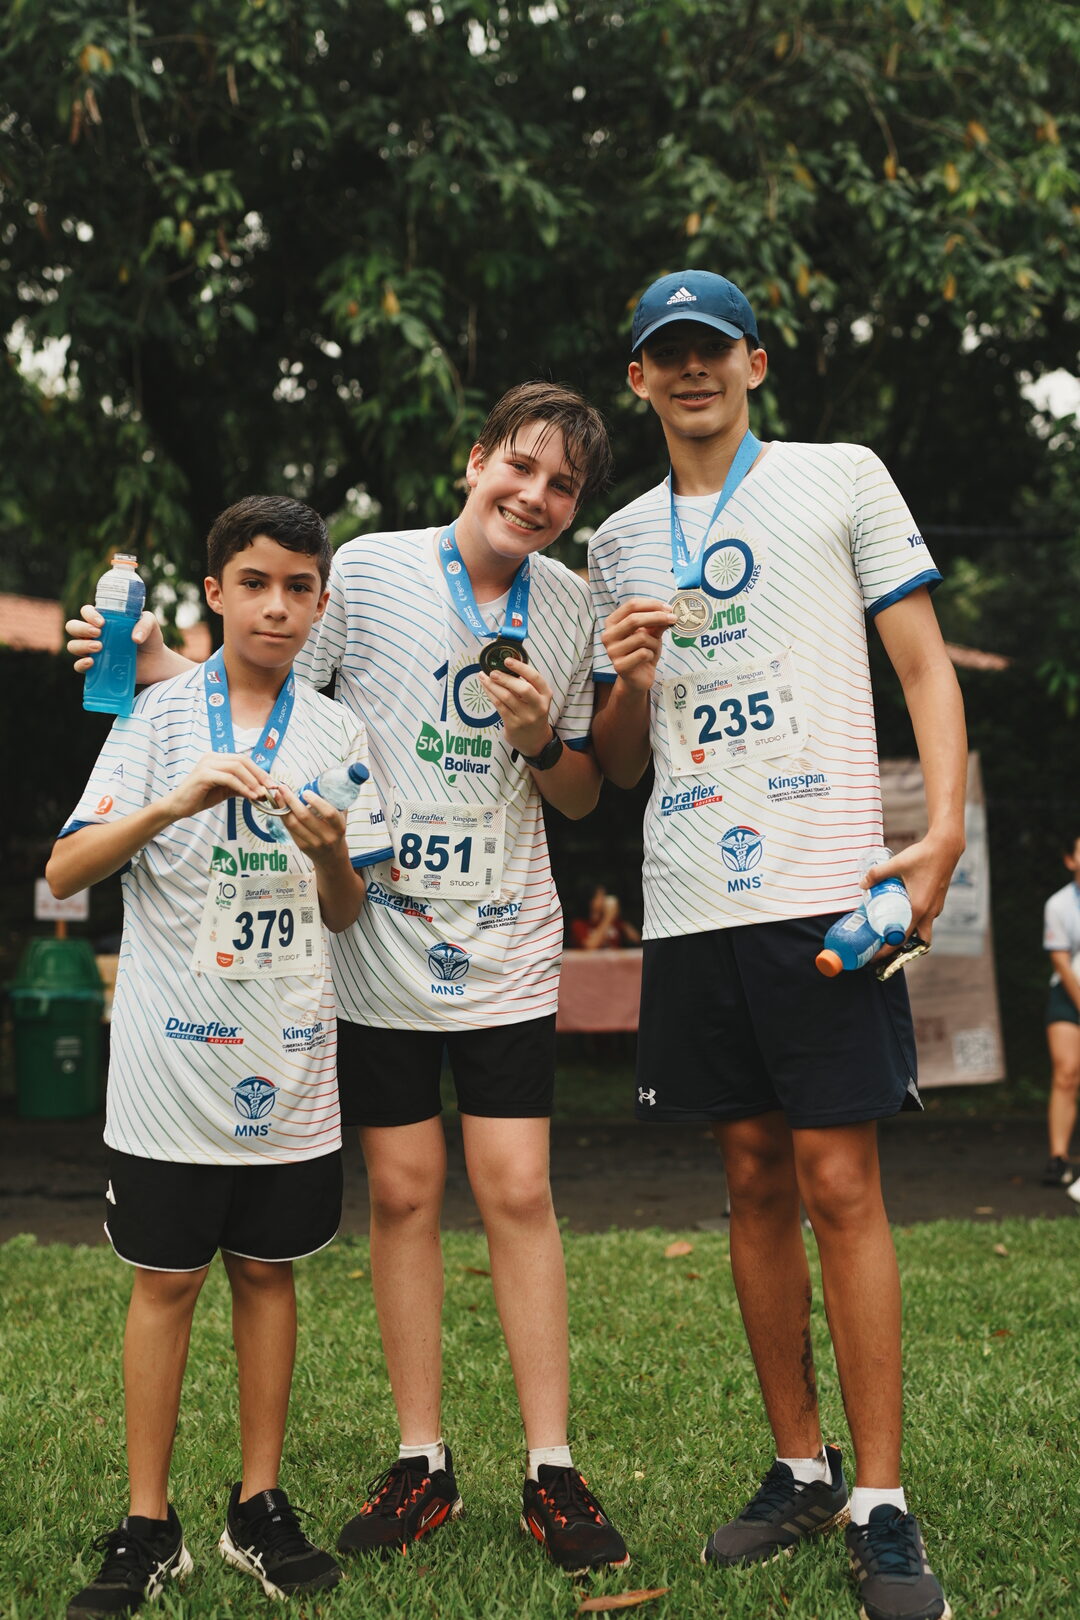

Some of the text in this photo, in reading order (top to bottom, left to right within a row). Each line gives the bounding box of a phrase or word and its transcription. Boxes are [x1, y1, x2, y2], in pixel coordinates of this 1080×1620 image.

[743, 564, 762, 594] YEARS
[709, 603, 746, 630] erde
[700, 628, 748, 648] Bolívar
[736, 670, 764, 681] Kingspan
[696, 679, 728, 692] Duraflex
[693, 691, 775, 744] 235
[417, 729, 492, 758] 5K Verde
[755, 735, 781, 746] STUDIO
[444, 757, 490, 774] Bolívar
[768, 773, 825, 790] Kingspan
[661, 784, 716, 809] Draflex
[411, 813, 444, 822] Duraflex
[452, 815, 478, 823] Kingspan
[211, 847, 287, 872] 5K Verde
[399, 832, 472, 873] 851
[219, 882, 236, 899] 10
[245, 888, 270, 897] Duraflex
[727, 876, 762, 893] MNS
[367, 881, 428, 914] Duraflex
[232, 908, 294, 951] 379
[431, 983, 464, 996] MNS
[165, 1017, 238, 1038] Duraflex
[170, 1032, 206, 1042] MUSCULAR
[234, 1124, 269, 1137] MNS
